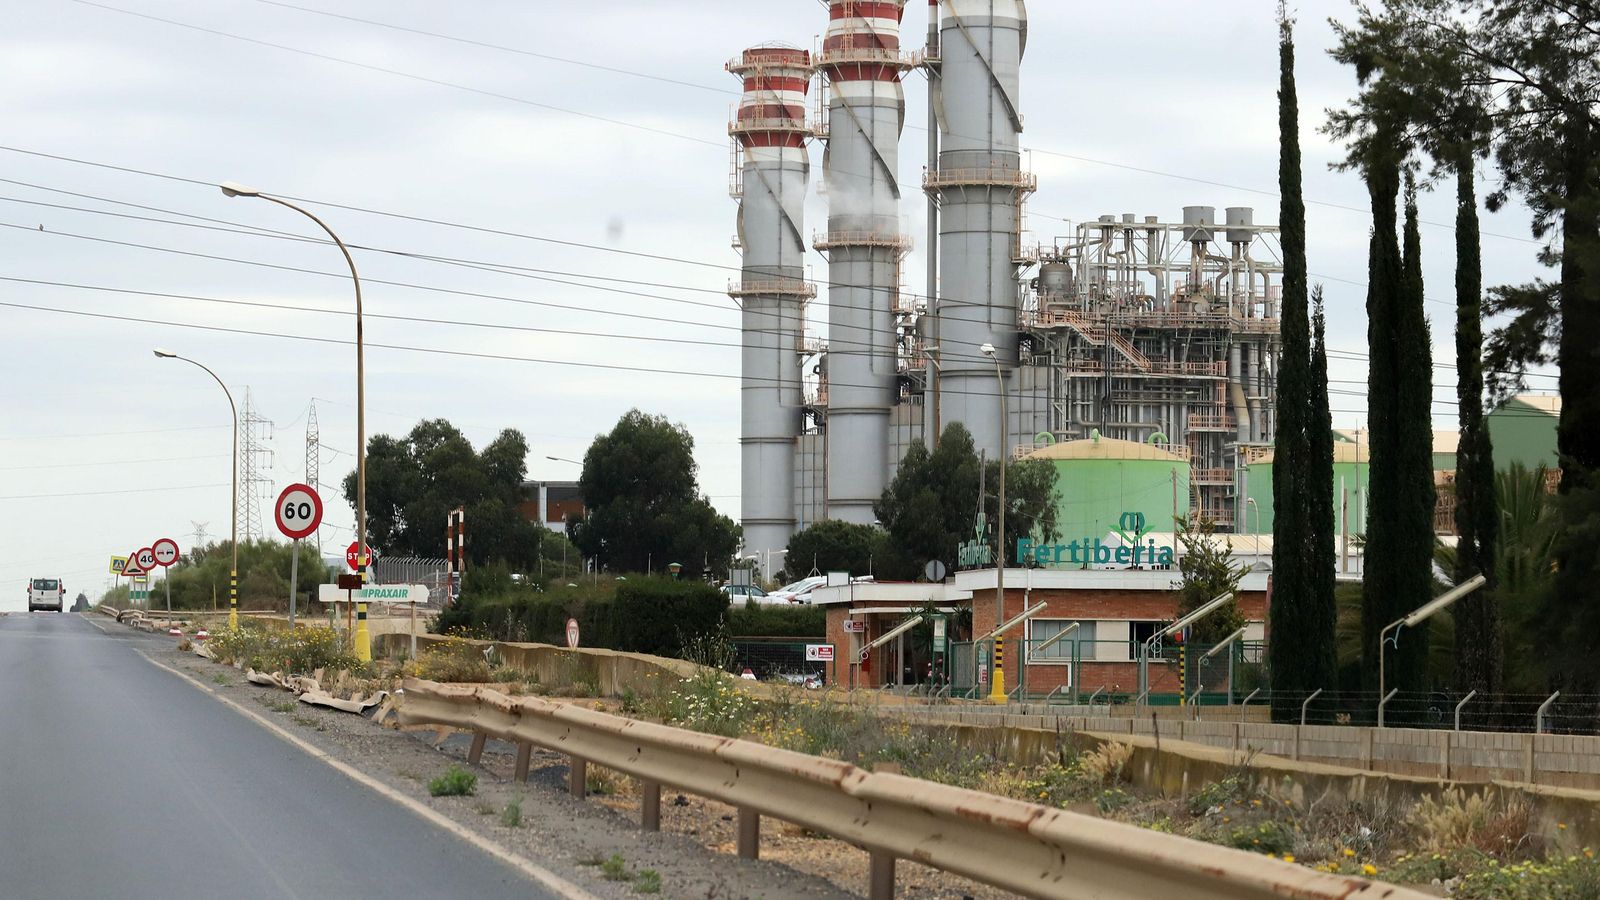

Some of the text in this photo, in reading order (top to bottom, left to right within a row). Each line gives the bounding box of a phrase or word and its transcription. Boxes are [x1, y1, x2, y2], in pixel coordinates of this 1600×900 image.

[285, 502, 311, 520] 60
[347, 552, 370, 560] STP
[1016, 537, 1174, 565] Fertiberia
[140, 555, 153, 563] 40
[368, 588, 408, 599] PRAXAIR
